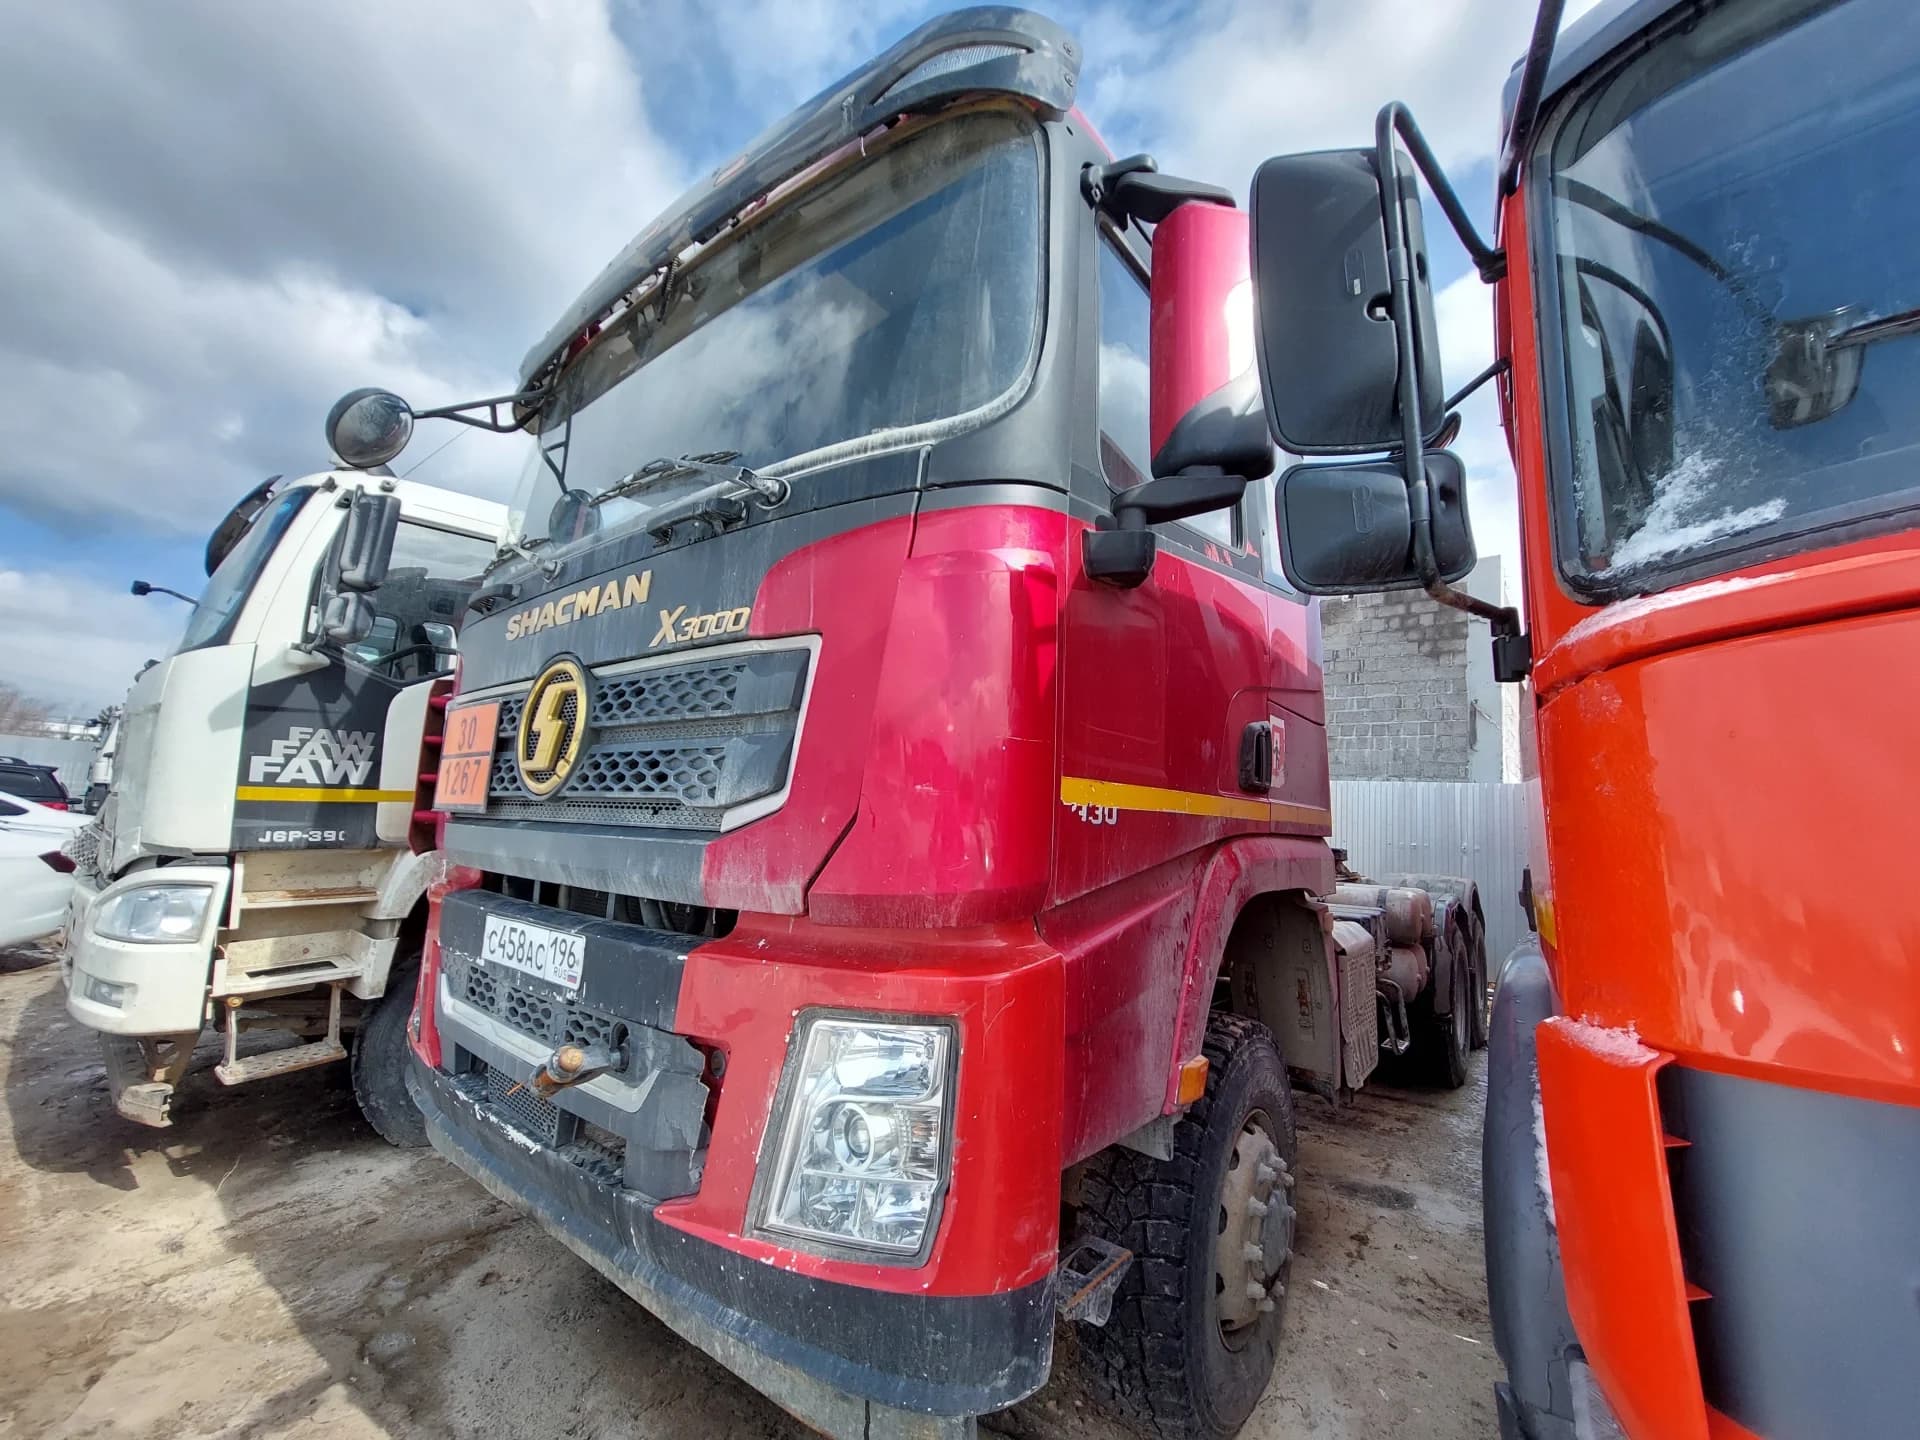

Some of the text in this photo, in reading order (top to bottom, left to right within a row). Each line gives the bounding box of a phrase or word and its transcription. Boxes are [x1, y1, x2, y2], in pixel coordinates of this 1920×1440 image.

[505, 570, 652, 641] SHACMAN
[648, 605, 751, 648] X3000
[289, 726, 376, 748] FAW
[458, 715, 477, 752] 30
[271, 740, 376, 765] FAW
[248, 755, 374, 785] FAW
[444, 759, 482, 796] 1267
[550, 936, 577, 969] 196
[553, 966, 567, 980] RUS
